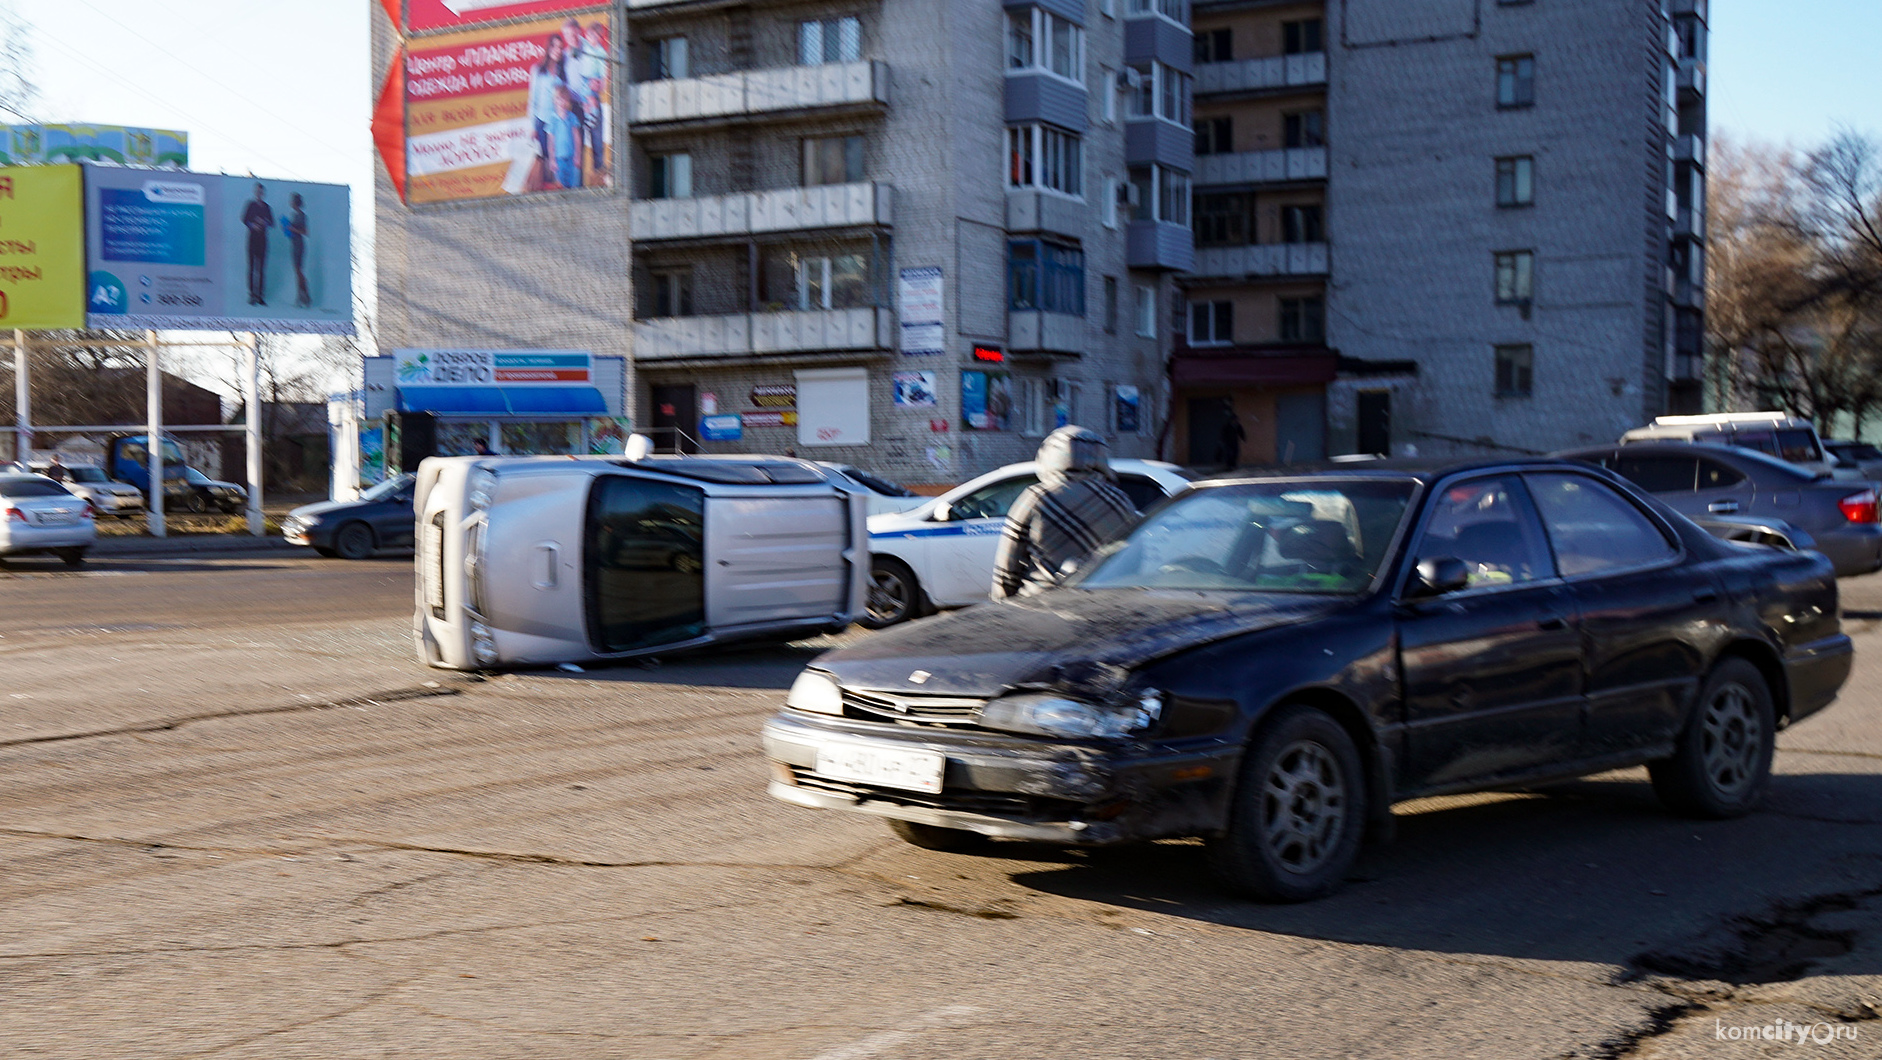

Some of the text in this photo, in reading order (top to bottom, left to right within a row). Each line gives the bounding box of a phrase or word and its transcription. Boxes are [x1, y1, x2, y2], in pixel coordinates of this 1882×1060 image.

[406, 40, 546, 77] Центр «ПЛАНЕТА»
[407, 65, 531, 98] ОДЕЖДА И ОБУВЬ
[432, 351, 492, 366] ДОБРОЕ
[432, 365, 491, 384] ДЕЛО
